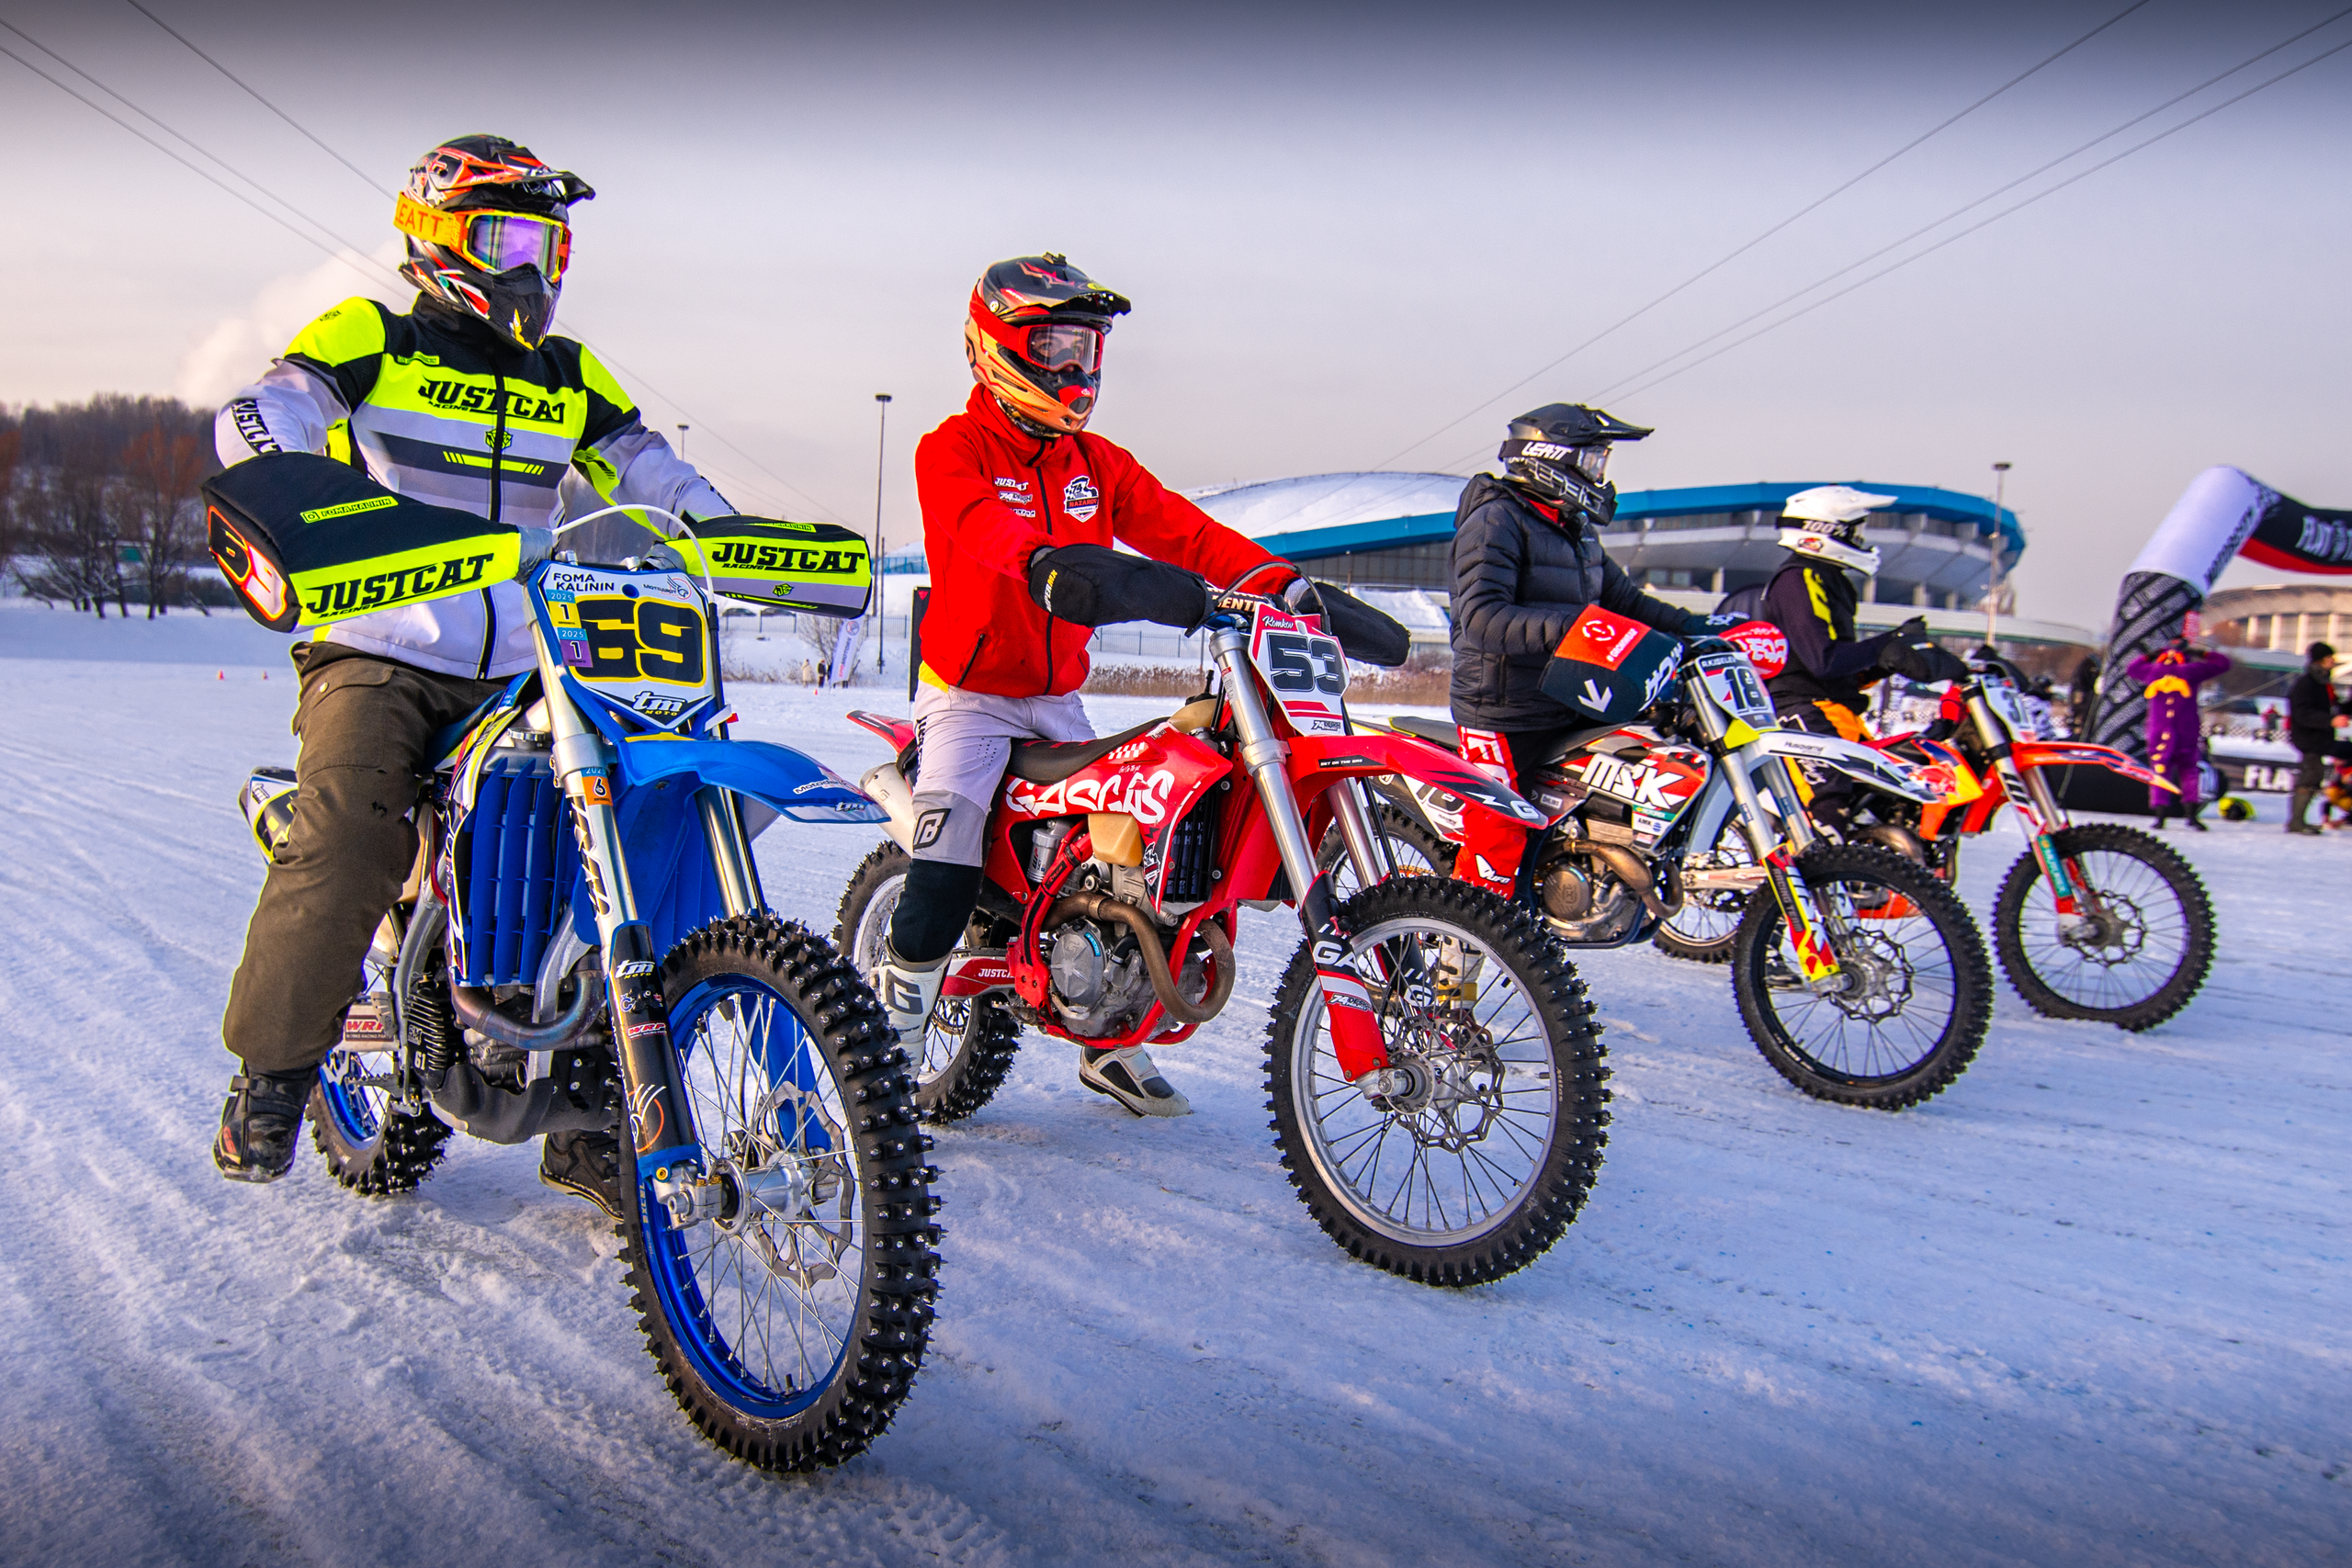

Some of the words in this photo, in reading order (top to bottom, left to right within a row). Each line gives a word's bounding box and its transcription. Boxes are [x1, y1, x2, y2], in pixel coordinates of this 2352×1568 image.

[418, 376, 566, 424] JUSTCAT
[1521, 441, 1575, 461] LEATT
[711, 542, 865, 574] JUSTCAT
[721, 562, 764, 571] RACING
[305, 553, 494, 615] JUSTCAT
[553, 572, 595, 583] FOMA
[555, 581, 615, 592] KALININ
[550, 592, 573, 602] 2025
[318, 603, 373, 619] RACING
[560, 603, 570, 621] 1
[1261, 615, 1295, 630] Komkov
[561, 629, 584, 639] 2025
[571, 597, 706, 685] 69
[570, 641, 582, 660] 1
[1266, 633, 1343, 697] 53
[1579, 752, 1687, 809] MSK
[2243, 764, 2300, 791] FLA
[624, 972, 652, 980] MOTO
[628, 1023, 667, 1036] WRP
